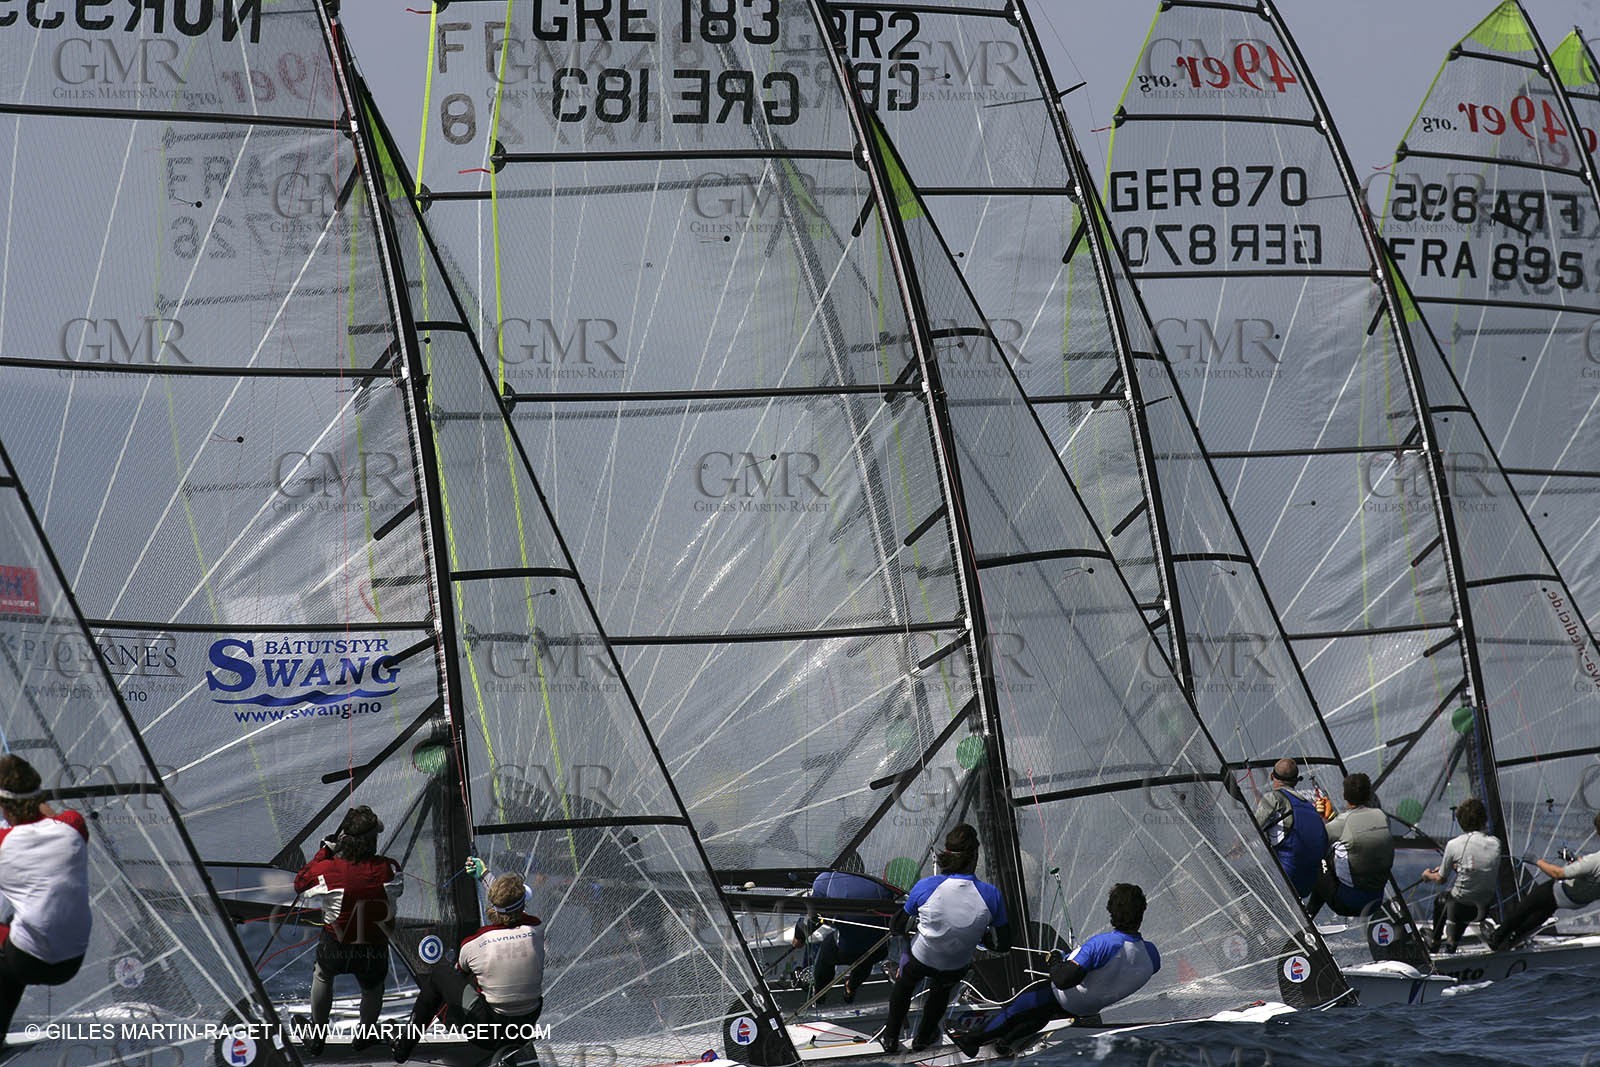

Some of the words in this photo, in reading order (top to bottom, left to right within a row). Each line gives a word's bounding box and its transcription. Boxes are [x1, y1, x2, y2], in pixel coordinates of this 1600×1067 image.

[533, 0, 656, 42] GRE
[682, 0, 779, 44] 183
[1388, 238, 1477, 279] FRA
[1491, 243, 1584, 289] 895
[206, 638, 401, 693] SWANG
[264, 637, 390, 655] BÅTUTSTYR
[234, 701, 382, 723] www.swang.no
